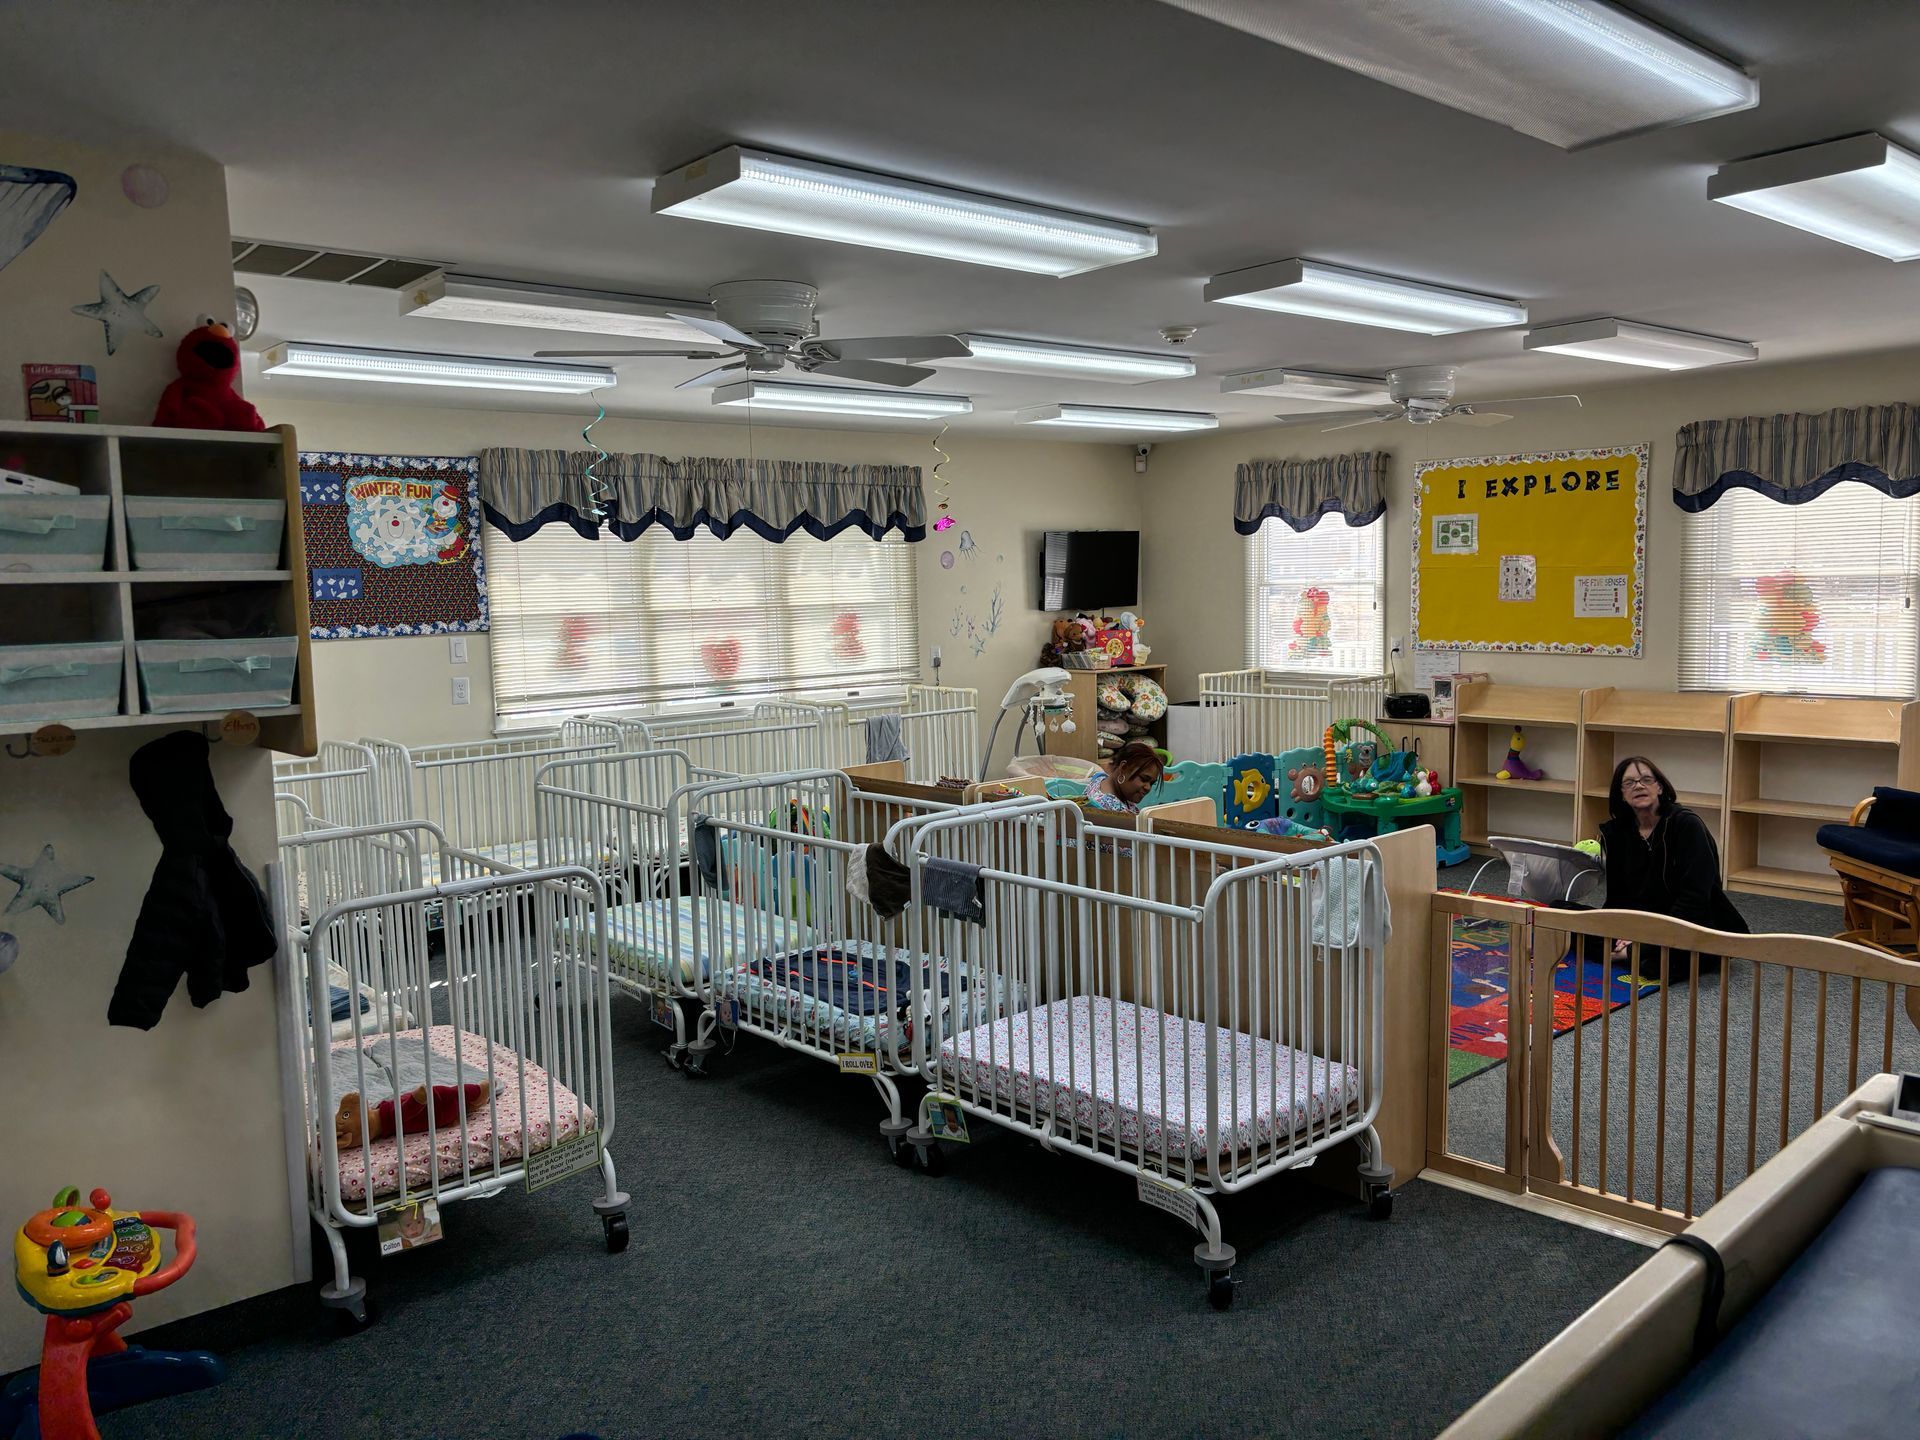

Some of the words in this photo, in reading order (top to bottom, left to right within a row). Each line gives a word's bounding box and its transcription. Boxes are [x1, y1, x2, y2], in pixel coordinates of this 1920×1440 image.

[350, 481, 402, 501] WINTER
[405, 483, 433, 499] FUN
[1458, 479, 1467, 499] I
[1486, 469, 1620, 499] EXPLORE
[1578, 579, 1590, 587] THE
[1604, 577, 1626, 587] SENSES
[845, 1060, 859, 1069] ROLL
[860, 1060, 874, 1069] OVER
[529, 1162, 543, 1173] their
[545, 1155, 563, 1167] BACK
[571, 1147, 583, 1155] crib
[583, 1140, 595, 1150] and
[540, 1167, 549, 1175] the
[550, 1161, 564, 1173] floor
[565, 1152, 584, 1165] (never
[530, 1176, 544, 1186] their
[545, 1164, 574, 1180] stomach)
